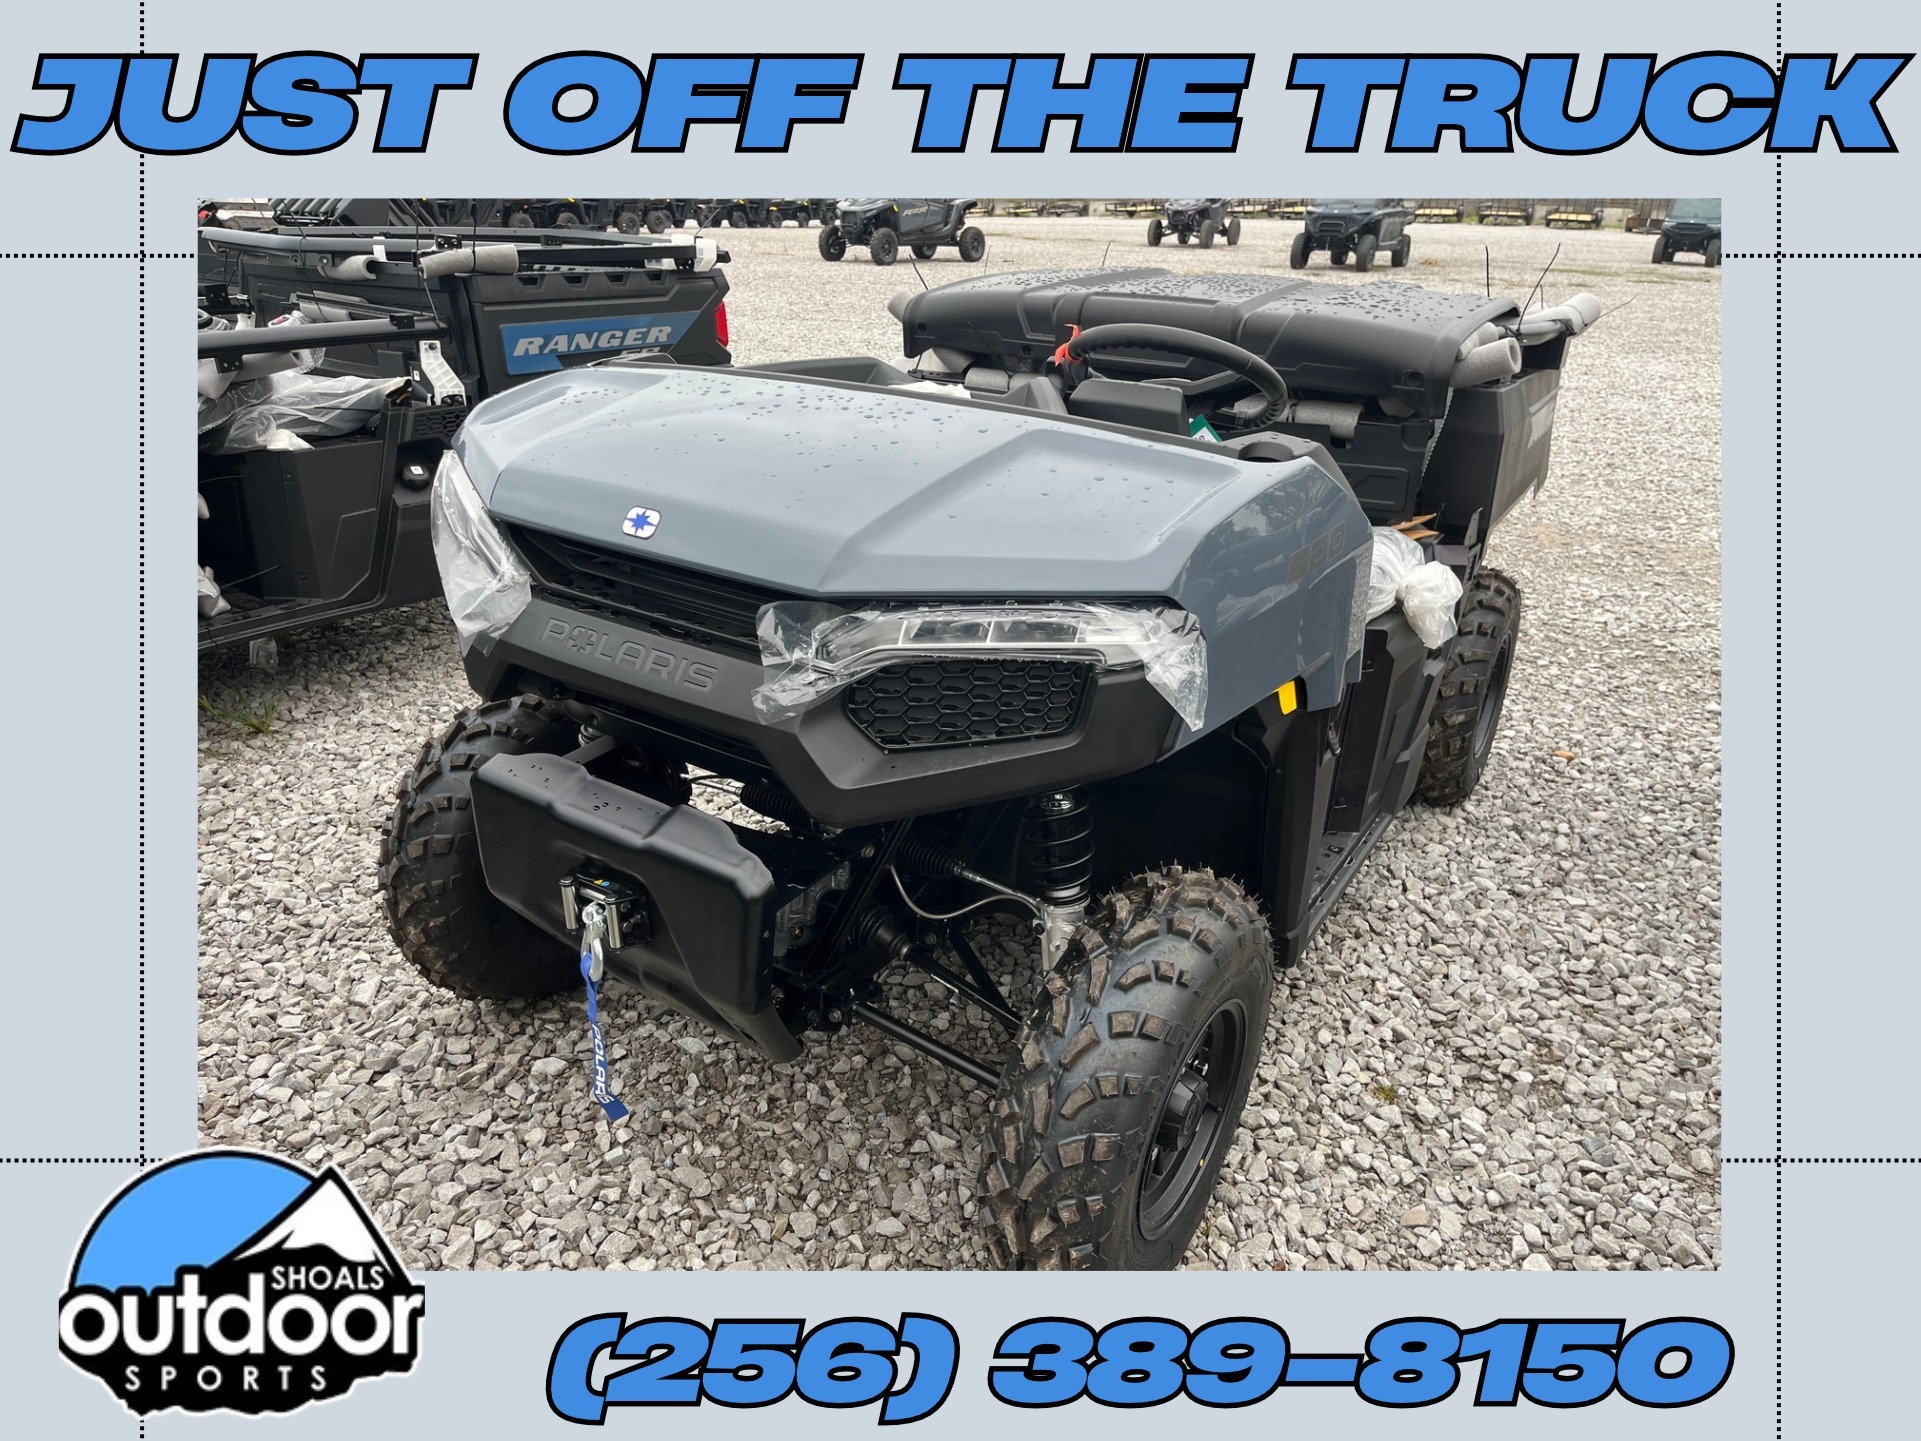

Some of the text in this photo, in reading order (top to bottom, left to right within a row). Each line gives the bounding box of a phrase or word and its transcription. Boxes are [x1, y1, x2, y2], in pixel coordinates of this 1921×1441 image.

[513, 326, 672, 357] RANGER
[540, 617, 719, 694] POLARIS
[592, 1023, 615, 1104] POLARIS
